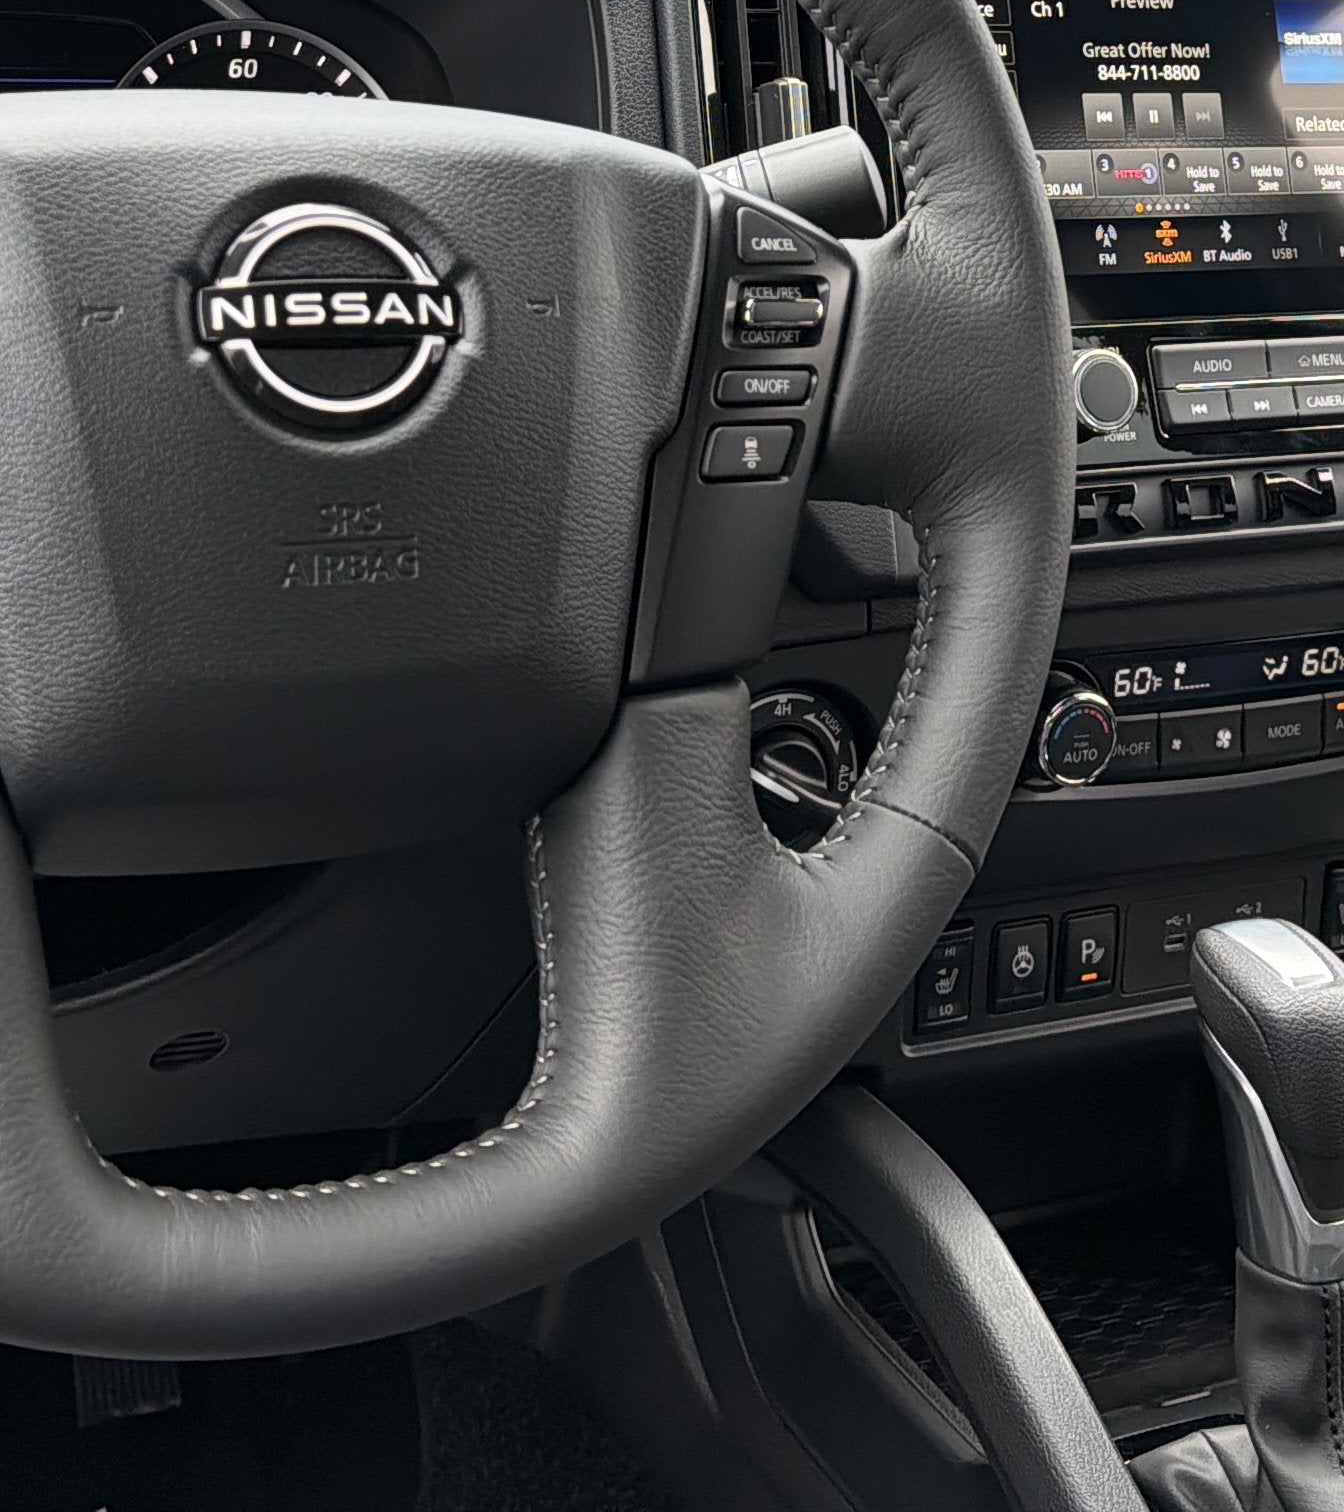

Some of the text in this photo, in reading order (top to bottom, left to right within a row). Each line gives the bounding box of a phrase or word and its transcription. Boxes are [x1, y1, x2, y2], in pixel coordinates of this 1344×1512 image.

[1030, 0, 1065, 18] Ch 1
[1082, 41, 1210, 59] Great Offer Now!
[227, 58, 258, 79] 60
[1097, 64, 1200, 81] 844-711-8800
[1100, 157, 1110, 172] 3
[1166, 157, 1177, 170] 4
[1232, 156, 1241, 169] 5
[1295, 155, 1304, 168] 6
[1186, 167, 1219, 179] Hold to
[1251, 166, 1283, 178] Hold to
[1314, 165, 1334, 177] Hold
[1062, 182, 1083, 196] AM
[1193, 181, 1216, 193] Save
[1258, 179, 1280, 192] Save
[1321, 178, 1342, 191] Save
[751, 237, 798, 252] CANCEL
[1099, 254, 1117, 266] FM
[1144, 251, 1193, 265] SiriusXM
[1203, 249, 1253, 262] BT Audio
[1272, 247, 1299, 261] USB1
[742, 286, 803, 300] ACCEL/RES
[209, 291, 454, 331] NISSAN
[741, 330, 801, 345] COAST/SET
[1192, 358, 1233, 374] AUDIO
[744, 378, 791, 394] ON/OFF
[1103, 431, 1137, 443] POWER
[280, 548, 421, 587] AIRBAG
[774, 703, 792, 717] 4H
[819, 709, 843, 736] PUSH
[1267, 723, 1302, 739] MODE
[1063, 748, 1099, 764] AUTO
[837, 763, 850, 792] 4LO
[944, 946, 956, 958] HI
[939, 1004, 954, 1016] LO
